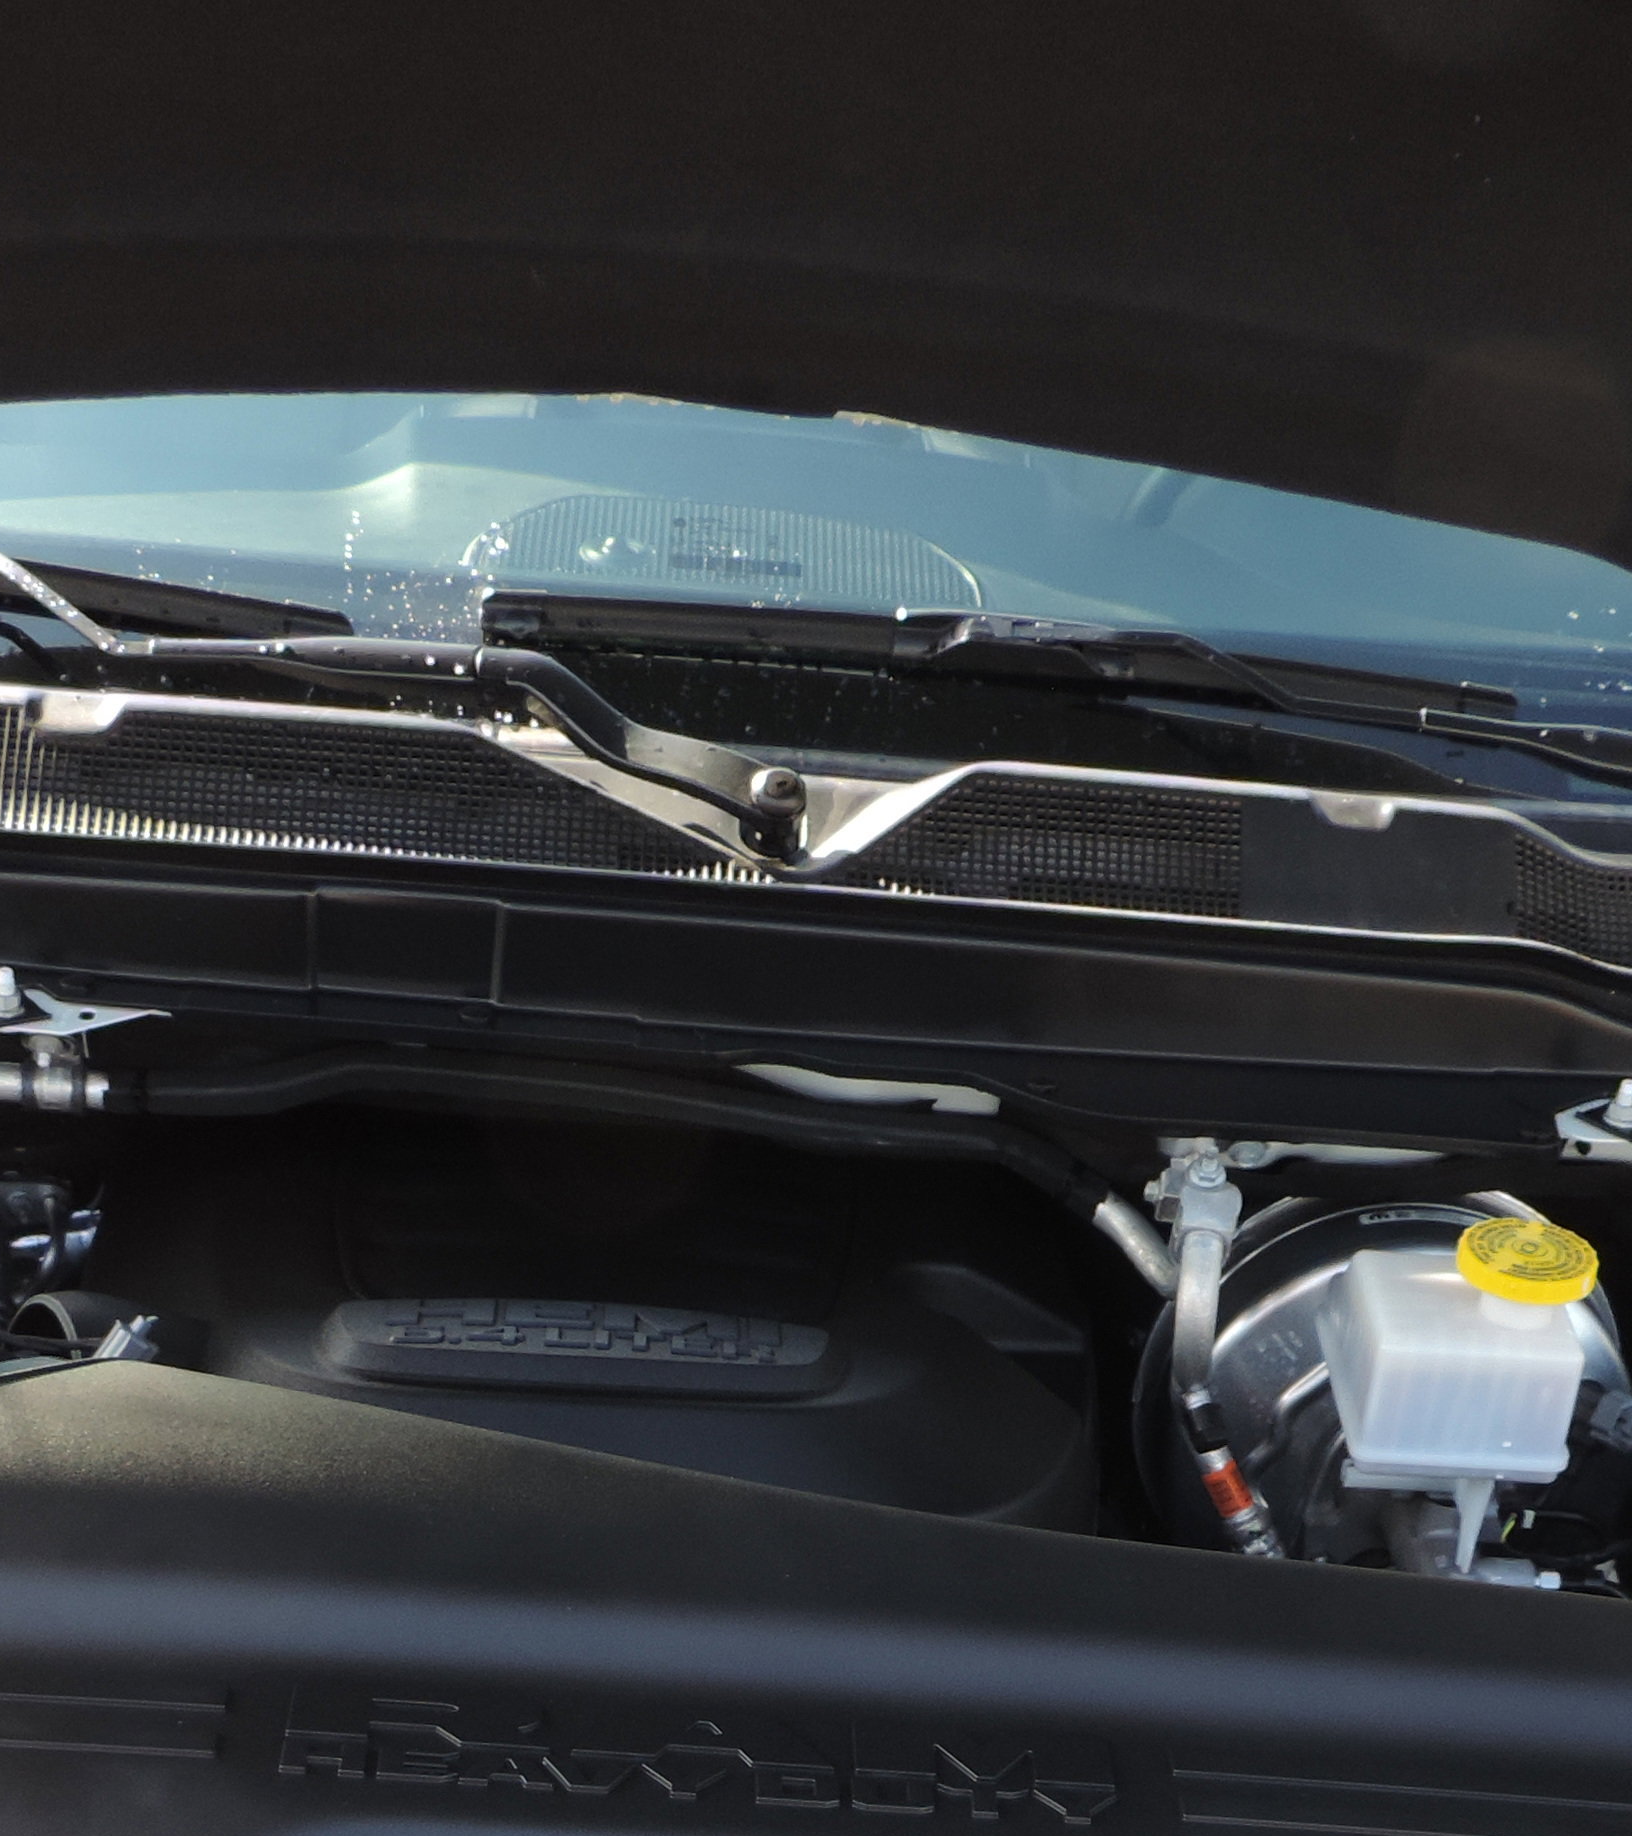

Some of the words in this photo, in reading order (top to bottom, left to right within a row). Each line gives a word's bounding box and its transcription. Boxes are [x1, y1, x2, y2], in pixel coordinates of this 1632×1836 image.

[384, 1299, 782, 1347] HEMI
[279, 1736, 728, 1801] HEAVY
[754, 1766, 1118, 1825] DUTY
